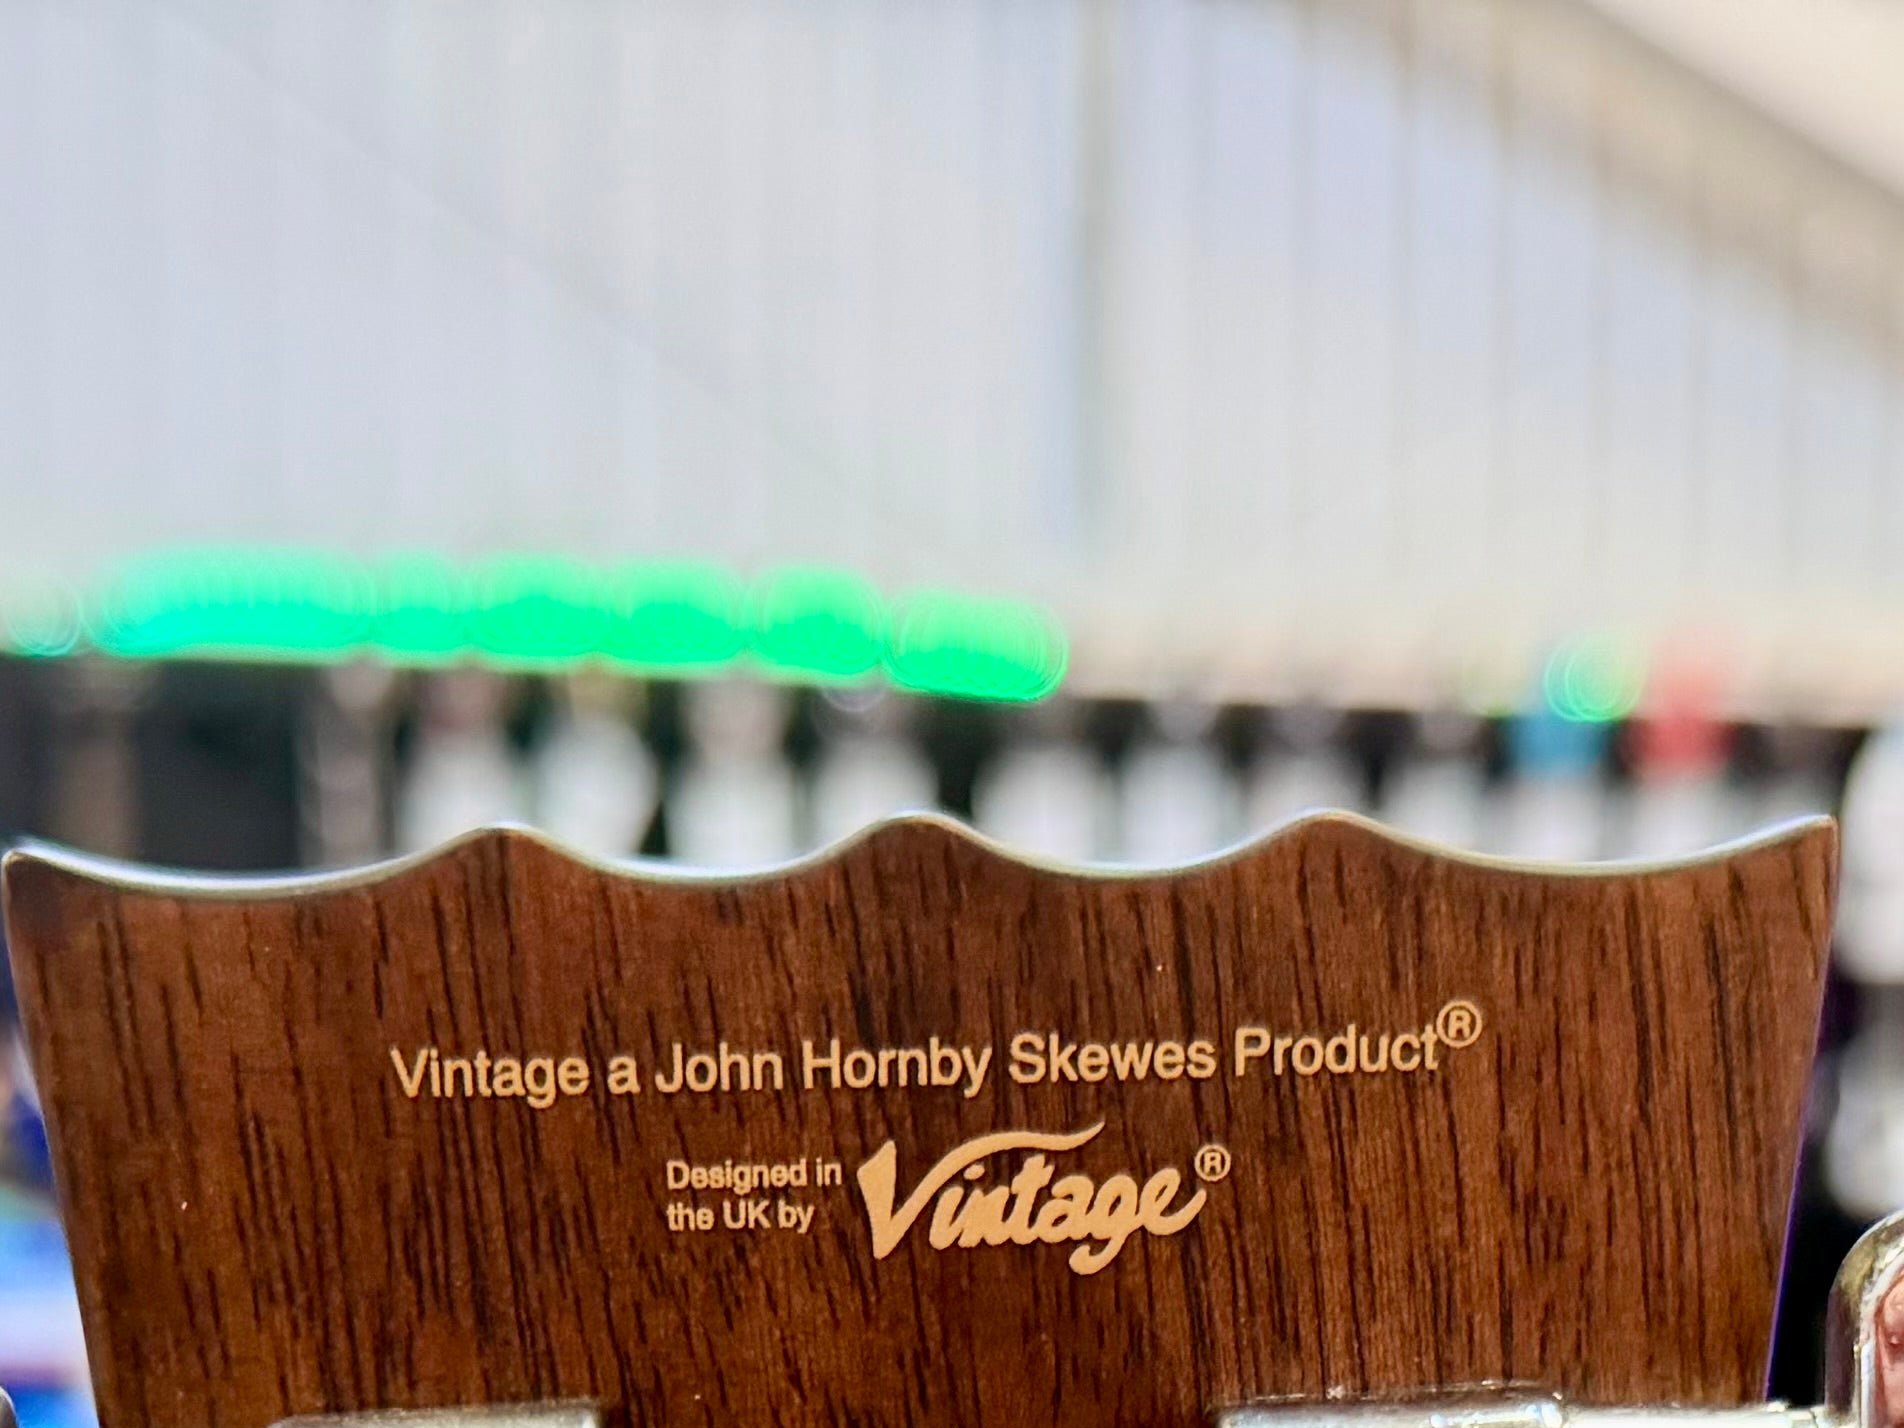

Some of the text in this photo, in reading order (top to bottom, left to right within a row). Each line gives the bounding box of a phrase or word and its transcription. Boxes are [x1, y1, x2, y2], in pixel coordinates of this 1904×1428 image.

[389, 1046, 590, 1110] Vintage
[606, 1054, 642, 1095] a
[654, 1040, 784, 1094] John
[801, 1035, 994, 1099] Hornby
[1007, 1031, 1218, 1084] Skewes
[665, 1156, 843, 1197] Designed in
[665, 1197, 816, 1235] the UK by
